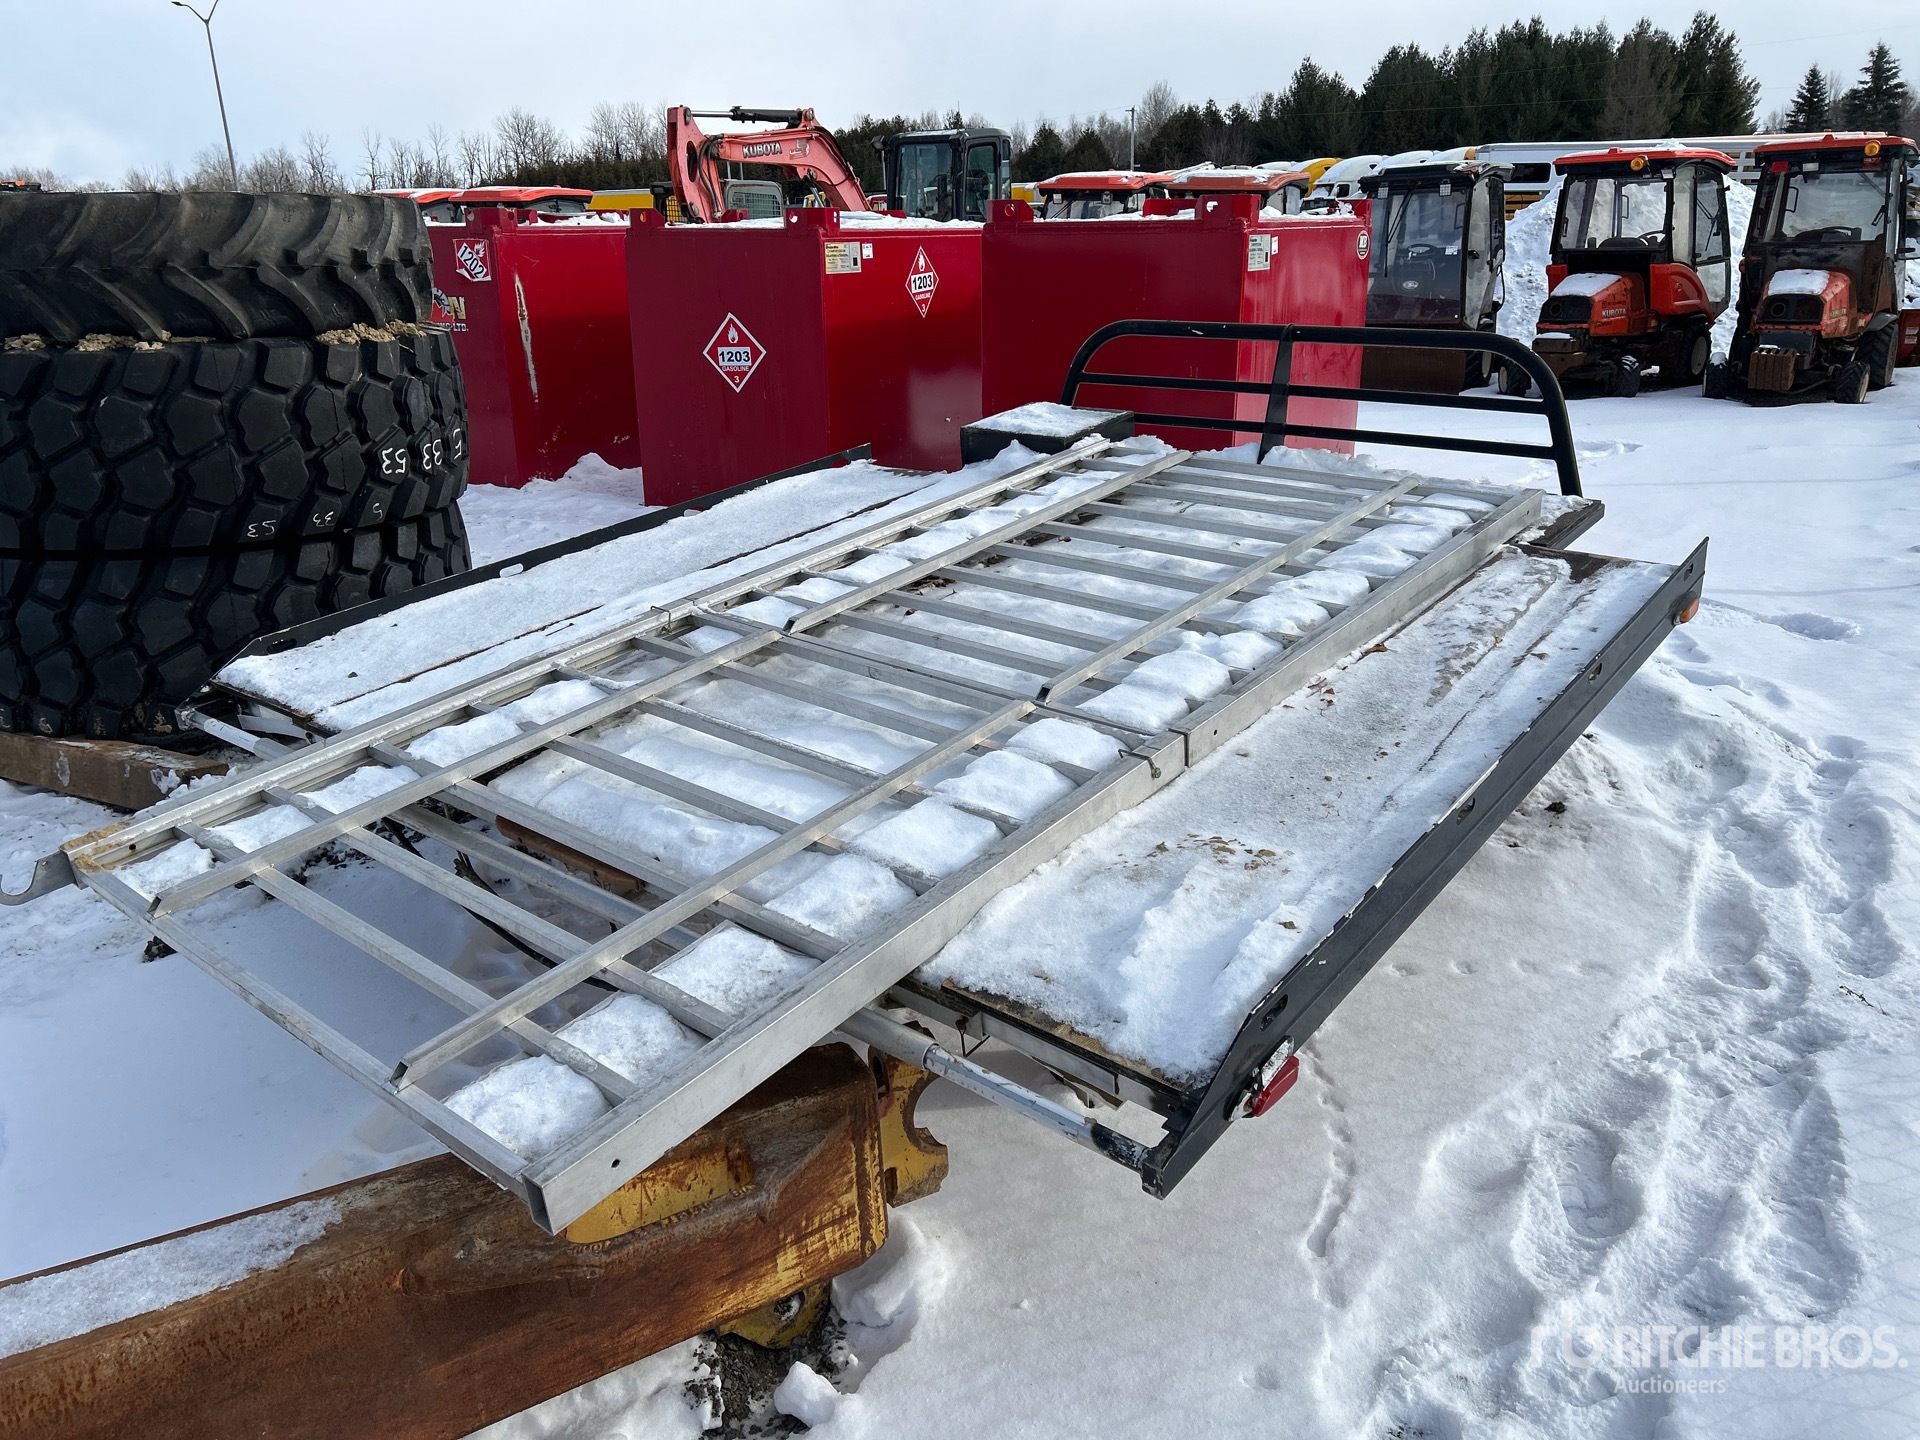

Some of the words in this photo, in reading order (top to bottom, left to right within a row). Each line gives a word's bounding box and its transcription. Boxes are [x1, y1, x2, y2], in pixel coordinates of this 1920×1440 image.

[742, 141, 782, 158] KUBOTA
[460, 245, 485, 279] 1202
[912, 274, 933, 290] 1203
[921, 303, 926, 312] 3
[1602, 308, 1627, 318] KUBOTA
[453, 322, 469, 332] LTD.
[719, 350, 751, 363] 1203
[734, 375, 740, 383] 3
[381, 447, 406, 474] 53
[422, 439, 442, 470] 33
